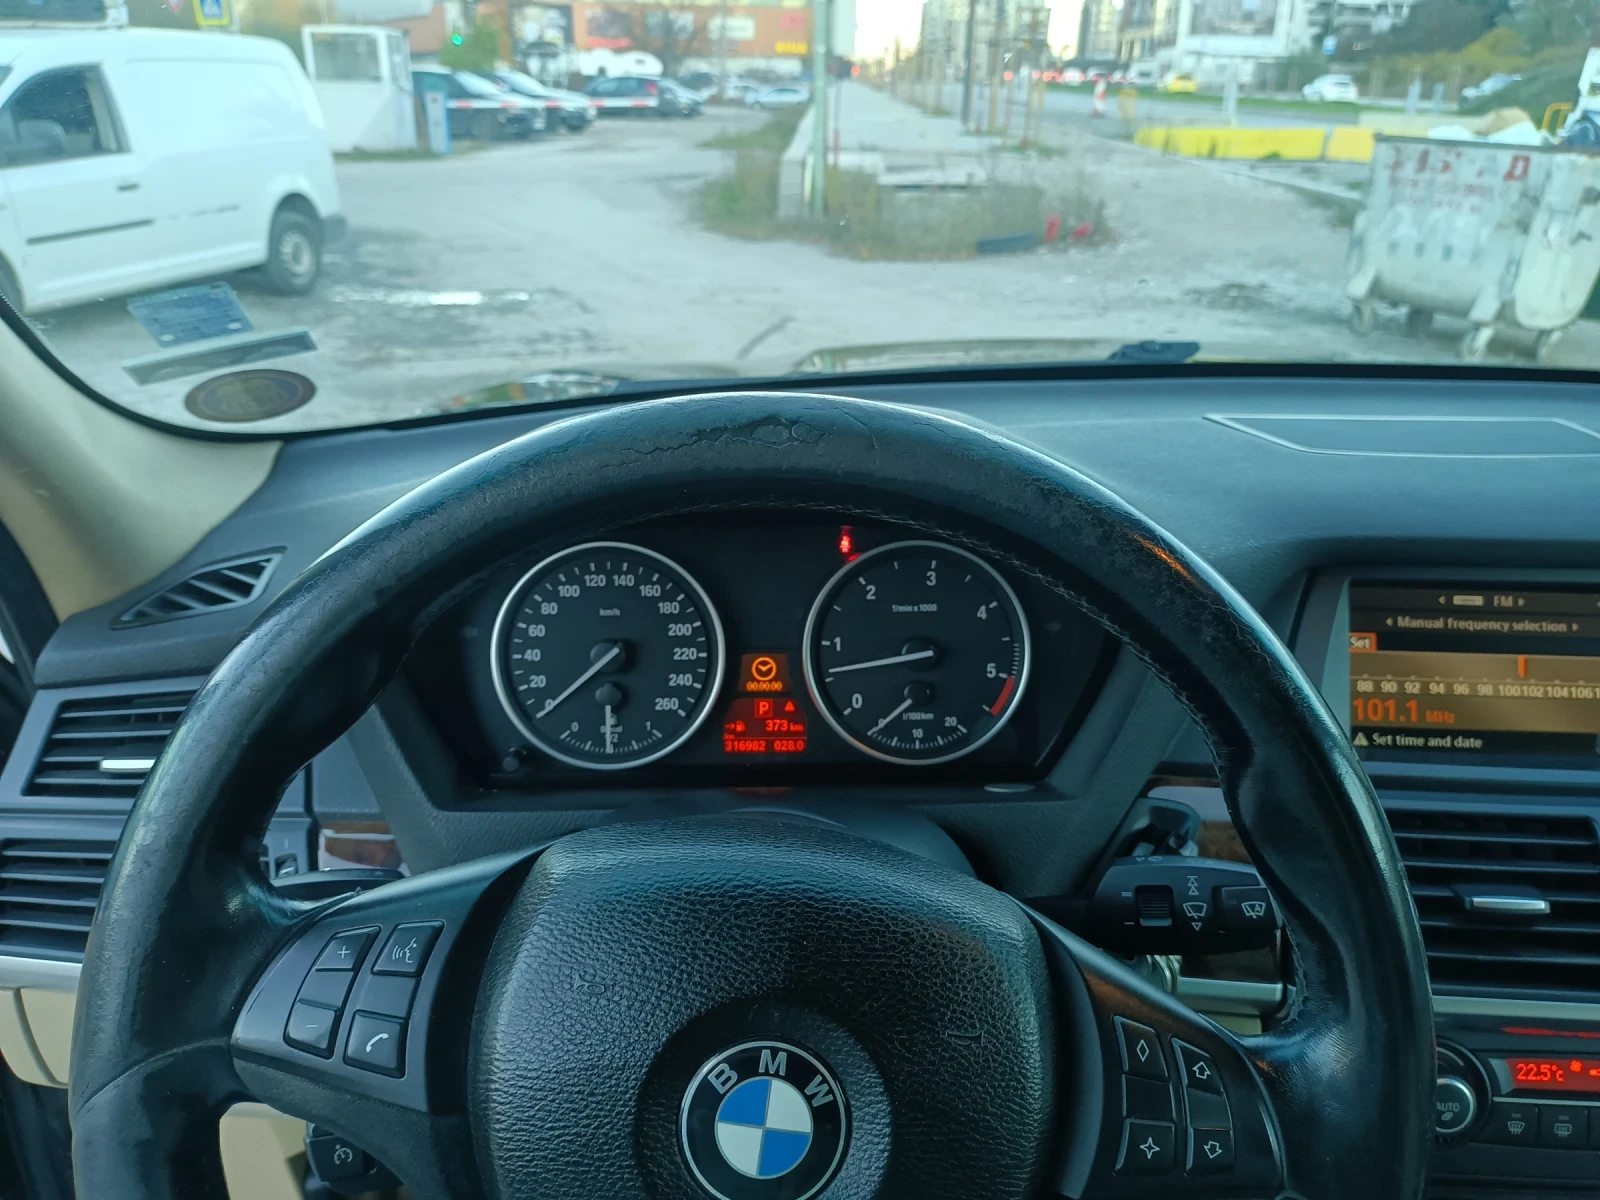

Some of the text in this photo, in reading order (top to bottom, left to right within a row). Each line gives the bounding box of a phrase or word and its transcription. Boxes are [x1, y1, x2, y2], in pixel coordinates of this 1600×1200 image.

[584, 574, 606, 587] 120
[613, 574, 635, 587] 140
[926, 571, 937, 586] 3
[558, 585, 580, 598] 100
[639, 585, 661, 597] 160
[866, 585, 876, 600] 2
[919, 603, 937, 612] 1000
[1493, 595, 1513, 607] FM
[540, 602, 558, 615] 80
[599, 608, 621, 617] km/h
[658, 602, 680, 614] 180
[977, 604, 987, 620] 4
[528, 624, 546, 637] 60
[668, 624, 692, 636] 200
[1397, 615, 1567, 633] Manual frequency selection
[833, 637, 841, 651] 1
[1350, 636, 1371, 648] Set
[524, 649, 541, 661] 40
[673, 648, 697, 660] 220
[986, 663, 996, 678] 5
[529, 675, 546, 688] 20
[668, 673, 693, 686] 240
[1356, 680, 1374, 693] 88
[1381, 681, 1398, 693] 90
[1404, 681, 1421, 694] 92
[1429, 682, 1446, 695] 94
[1453, 683, 1470, 696] 96
[1477, 683, 1493, 696] 98
[1498, 684, 1520, 697] 100
[1521, 685, 1544, 698] 102
[1546, 686, 1569, 698] 104
[1570, 686, 1593, 699] 106
[655, 698, 679, 710] 260
[759, 701, 769, 715] P
[852, 694, 863, 709] 0
[1352, 698, 1455, 724] 101.1 MHz
[571, 721, 579, 732] 0
[645, 720, 651, 731] 1
[765, 719, 804, 732] 373 km
[944, 716, 957, 727] 20
[912, 728, 923, 739] 10
[724, 740, 804, 752] 316982 028.0
[1372, 732, 1483, 749] Set time and date
[707, 1049, 834, 1108] BMW
[1436, 1102, 1460, 1112] AUTO
